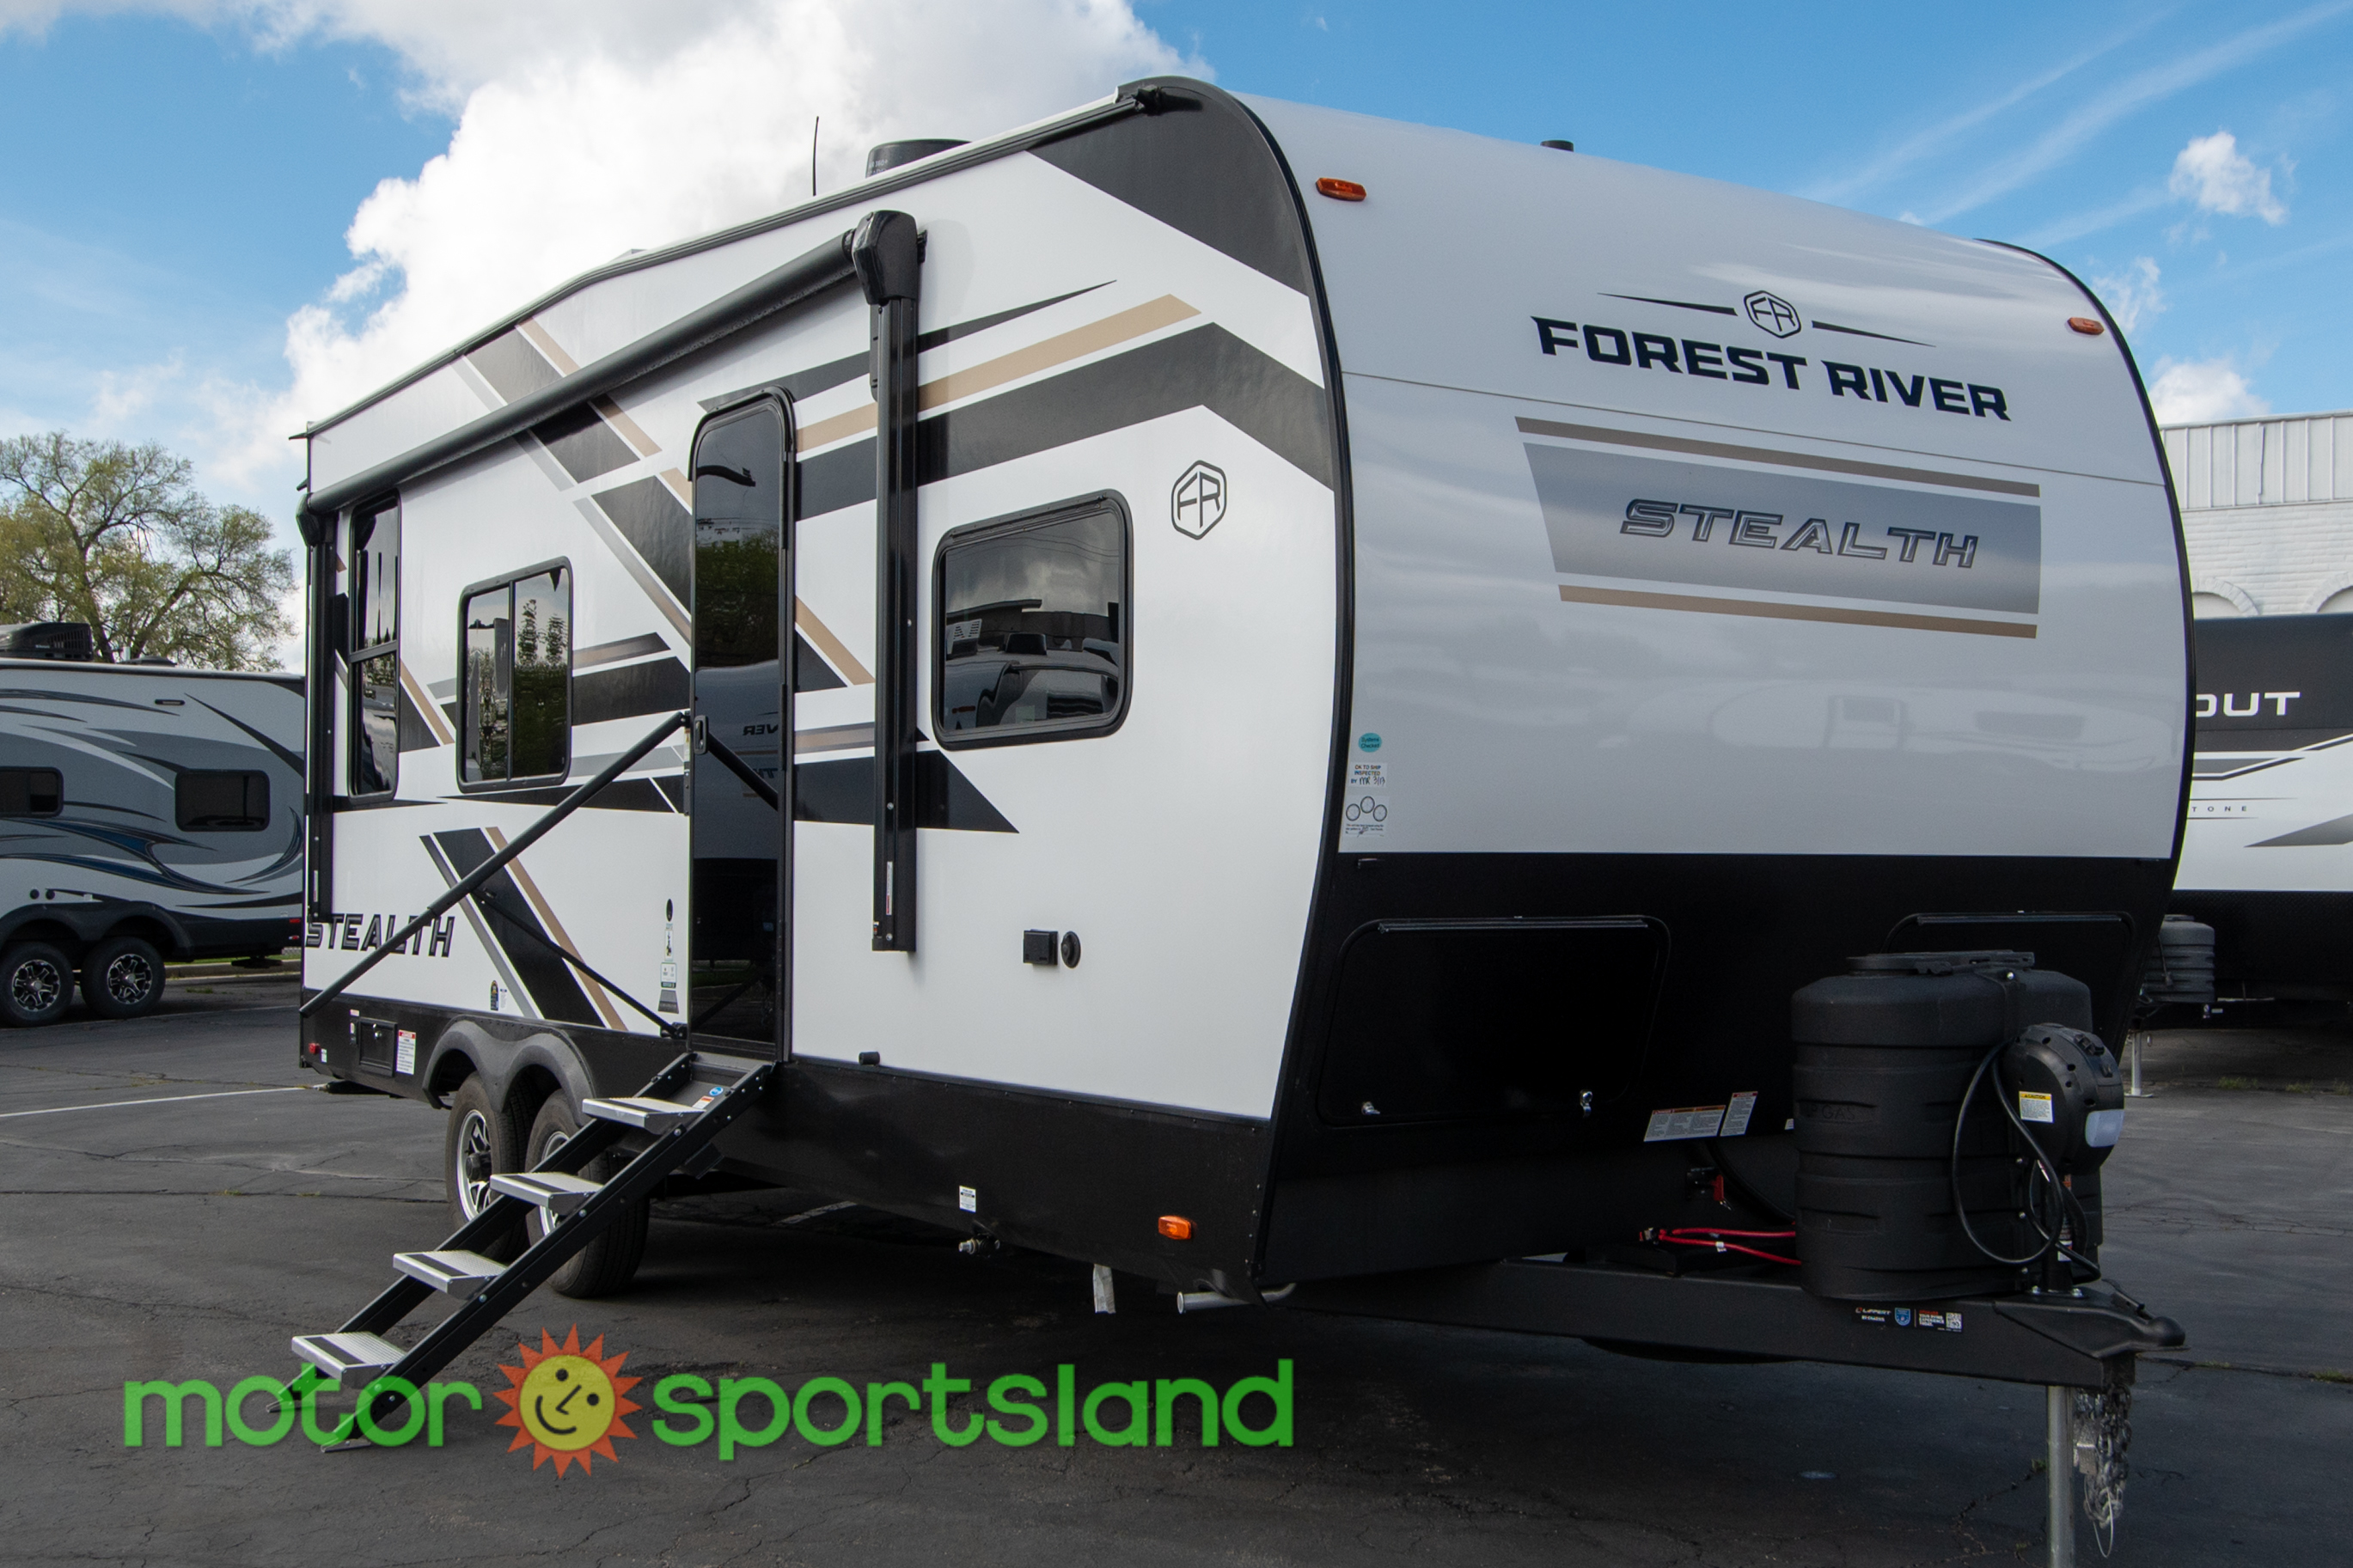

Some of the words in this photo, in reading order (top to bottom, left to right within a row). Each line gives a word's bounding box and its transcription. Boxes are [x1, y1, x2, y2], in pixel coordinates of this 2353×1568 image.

[1530, 315, 1807, 390] FOREST
[1821, 359, 2012, 422] RIVER
[1620, 497, 1979, 569] STEALTH
[304, 913, 455, 958] STEALTH
[1821, 1104, 1855, 1120] GAS
